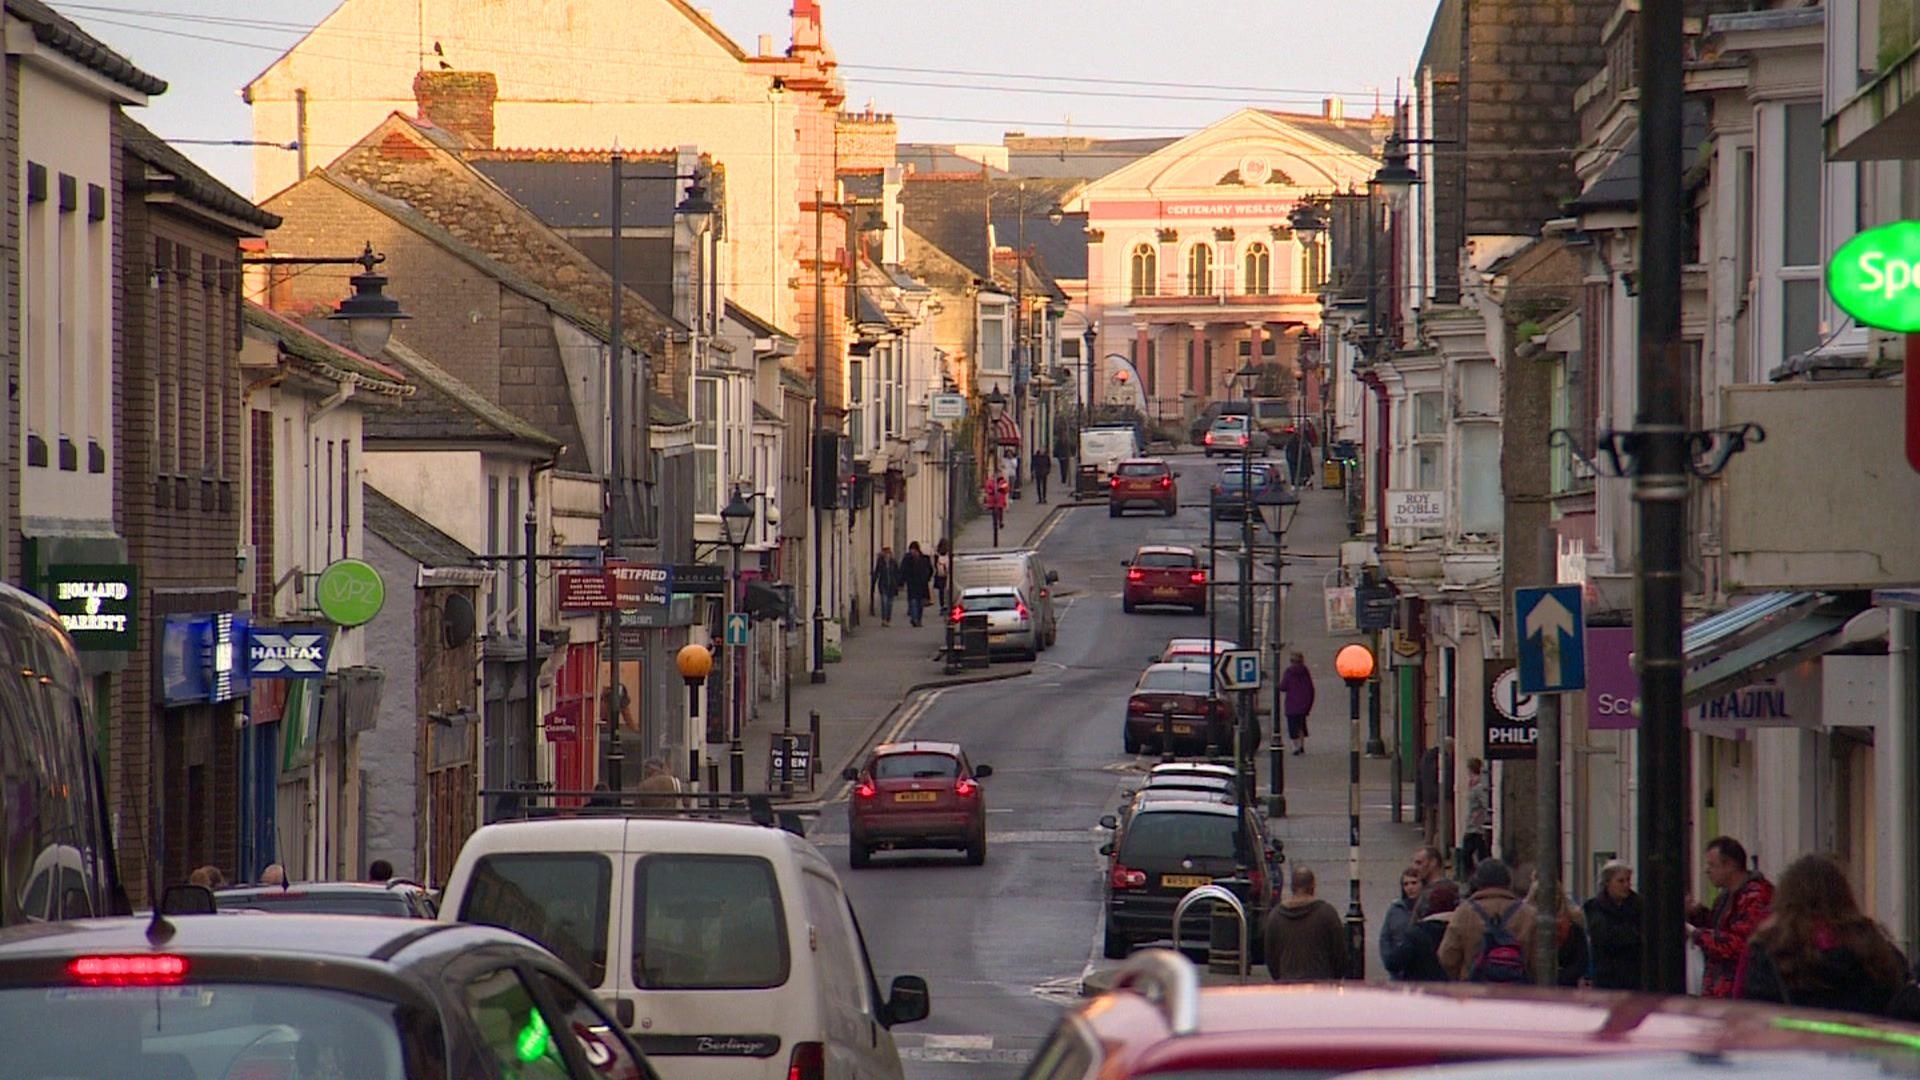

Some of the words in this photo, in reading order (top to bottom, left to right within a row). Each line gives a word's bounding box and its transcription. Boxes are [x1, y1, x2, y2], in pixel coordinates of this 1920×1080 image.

[1167, 205, 1232, 215] CENTENARY
[1406, 494, 1430, 504] ROY
[1397, 504, 1440, 514] DOBLE
[57, 582, 128, 600] HOLLAND
[323, 570, 377, 604] VPZ
[644, 593, 666, 604] king
[86, 597, 101, 615] &
[251, 646, 324, 660] HALIFAX
[1241, 660, 1254, 681] P
[774, 757, 807, 768] OEN
[697, 1036, 764, 1054] Berlingo
